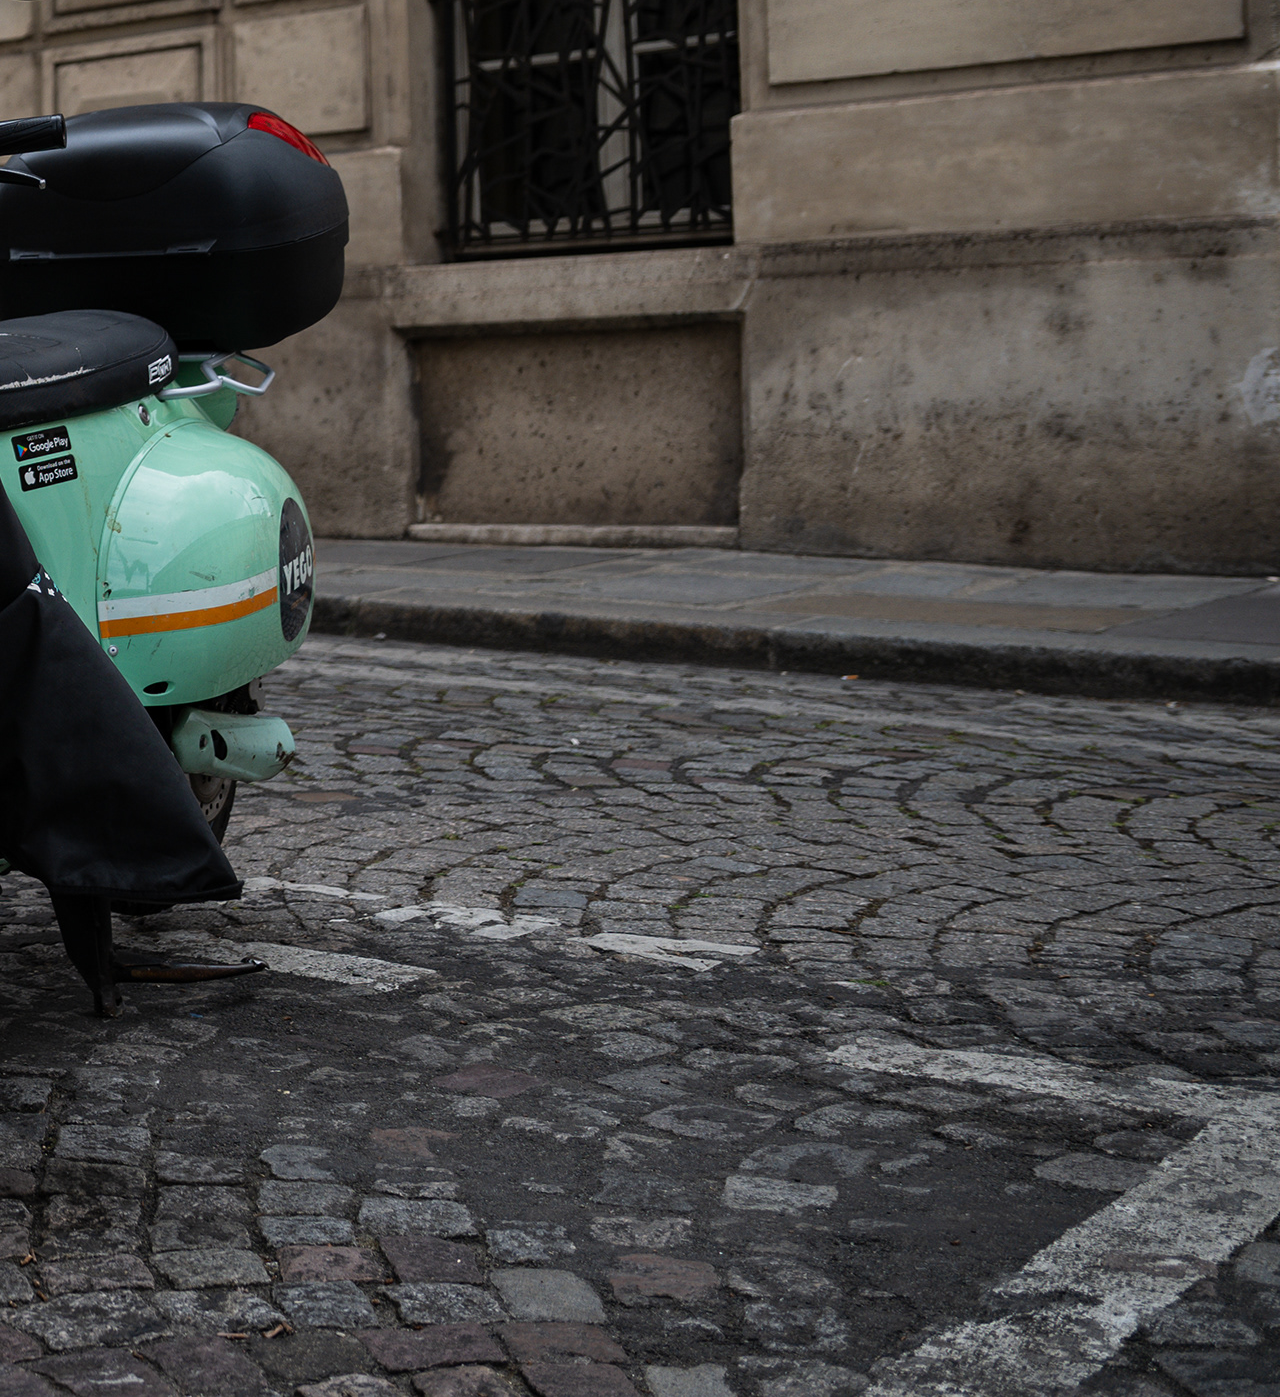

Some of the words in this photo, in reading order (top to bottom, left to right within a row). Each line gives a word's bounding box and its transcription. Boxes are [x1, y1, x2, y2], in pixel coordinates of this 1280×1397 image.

[29, 439, 54, 452] Google
[53, 437, 68, 447] Play
[37, 462, 57, 471] Download
[39, 472, 54, 483] App
[54, 467, 73, 479] Store
[282, 544, 313, 596] YEGO
